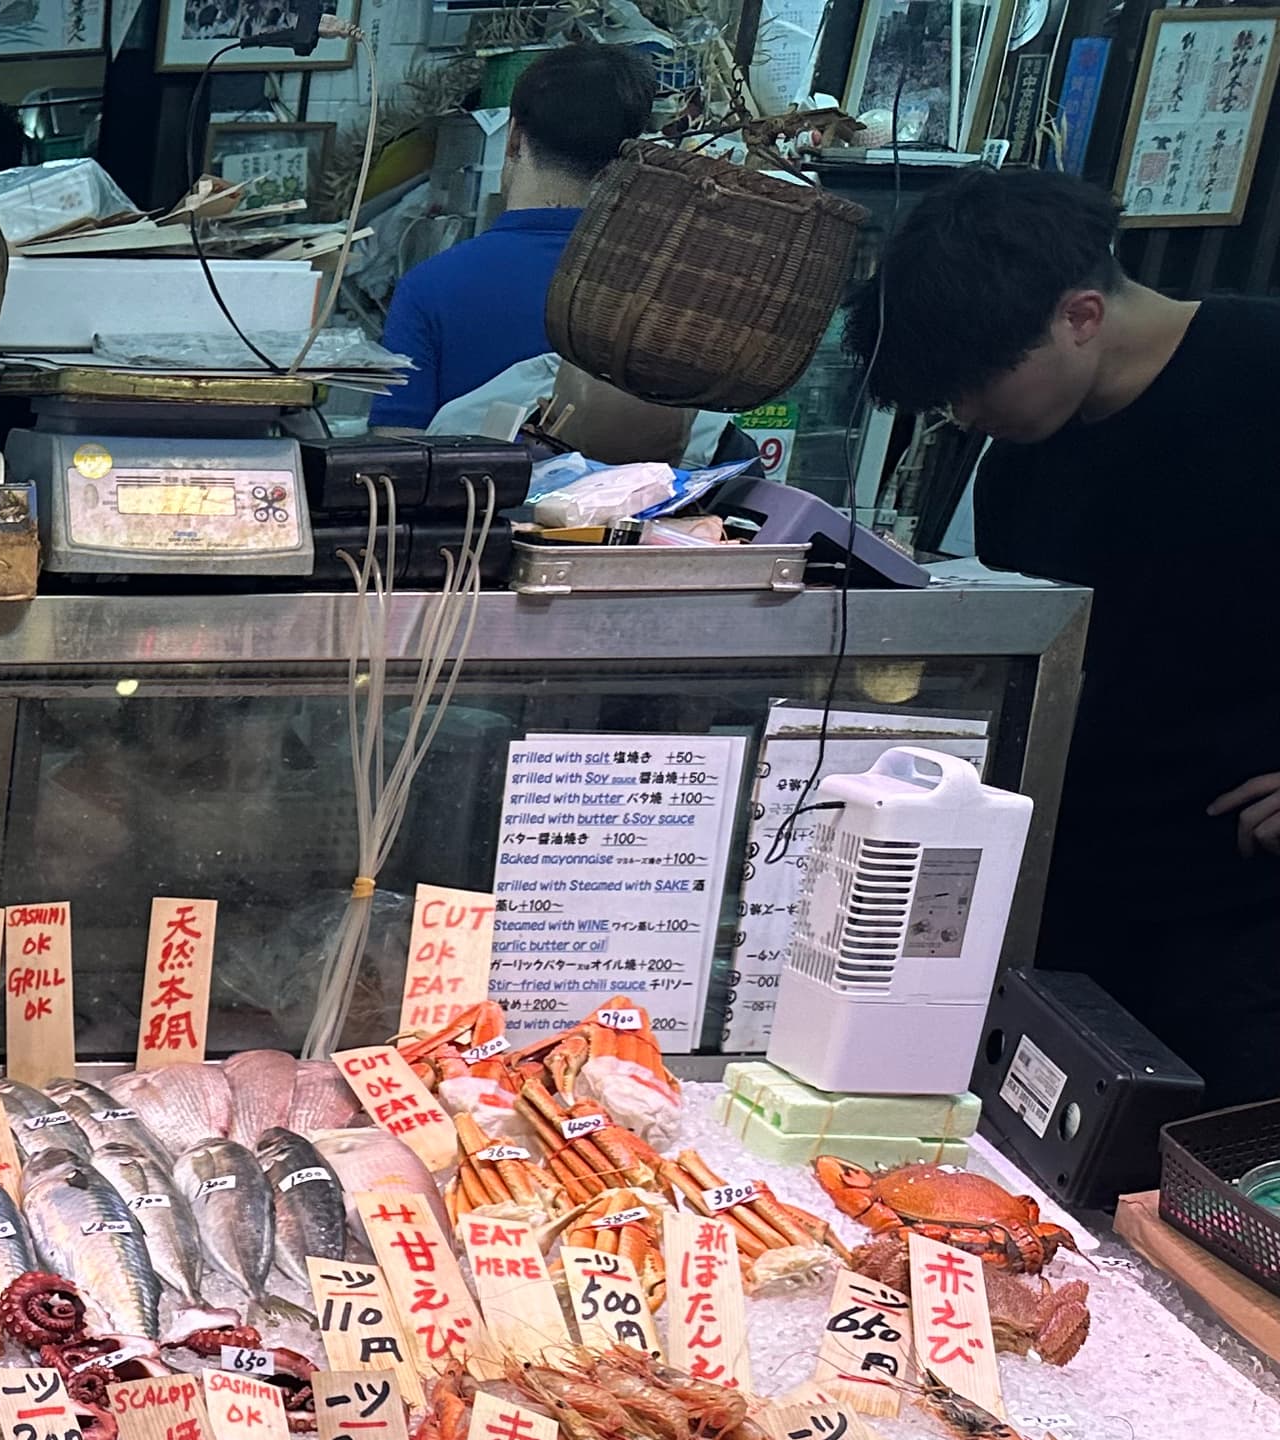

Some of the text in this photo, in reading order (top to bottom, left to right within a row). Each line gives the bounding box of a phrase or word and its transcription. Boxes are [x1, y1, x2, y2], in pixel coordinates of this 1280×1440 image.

[512, 751, 610, 764] grilled with salt
[511, 772, 582, 785] grilled with
[510, 793, 624, 805] grilled with butter
[504, 813, 618, 826] grilled with butter
[500, 853, 613, 866] Baked mayonnaise
[569, 879, 689, 891] Steamed with SAKE
[6, 906, 67, 928] SASHIMI
[420, 901, 496, 932] CUT
[494, 919, 609, 931] Steamed with WINE
[22, 934, 52, 955] OK
[529, 939, 570, 951] butter
[7, 967, 66, 993] GRILL
[143, 906, 203, 1051] 天然本鯛
[408, 976, 463, 998] EAT
[23, 1000, 53, 1020] OK
[343, 1052, 391, 1076] CUT
[386, 1109, 443, 1137] HERE
[469, 1223, 528, 1246] EAT
[474, 1255, 541, 1279] HERE
[580, 1282, 642, 1321] 500
[922, 1252, 984, 1364] 赤えび
[322, 1300, 384, 1333] 110
[827, 1308, 902, 1345] 650
[207, 1374, 281, 1400] SASHIMI
[226, 1406, 262, 1427] OK
